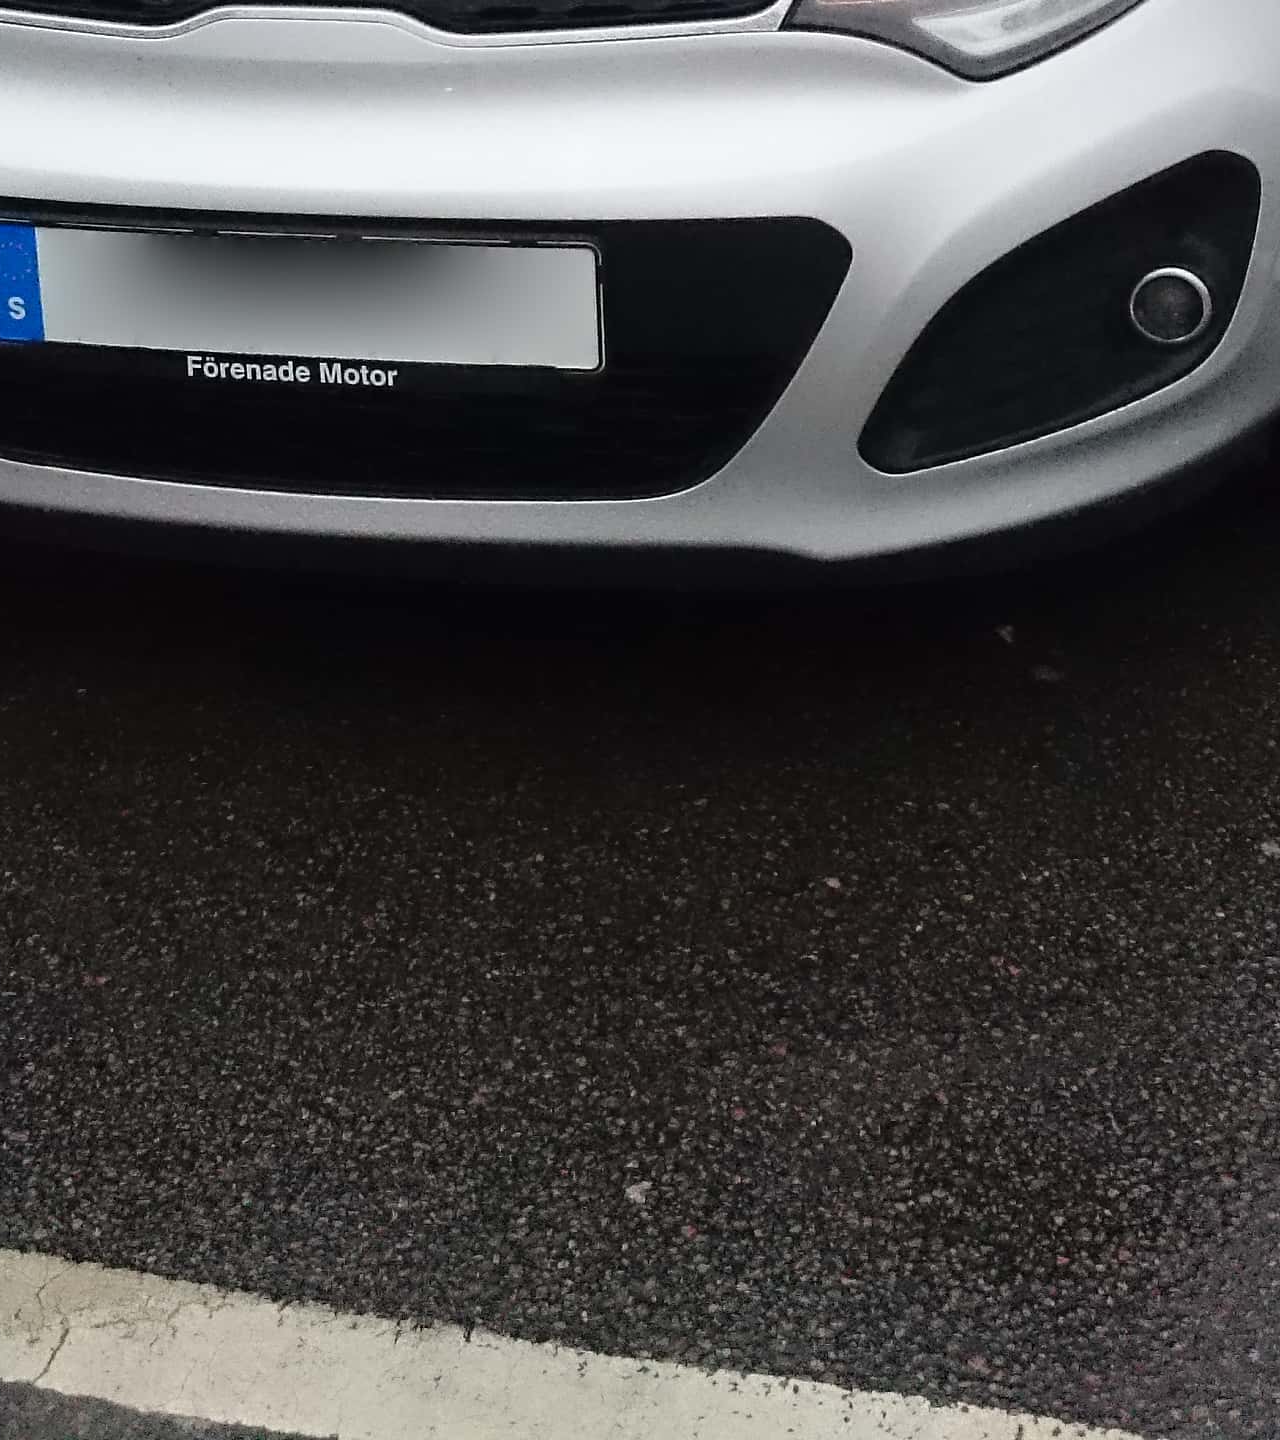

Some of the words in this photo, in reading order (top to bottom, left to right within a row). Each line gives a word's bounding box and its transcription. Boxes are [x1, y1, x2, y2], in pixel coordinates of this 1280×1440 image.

[7, 296, 27, 320] S
[186, 355, 311, 383] Förenade
[319, 362, 398, 387] Motor
